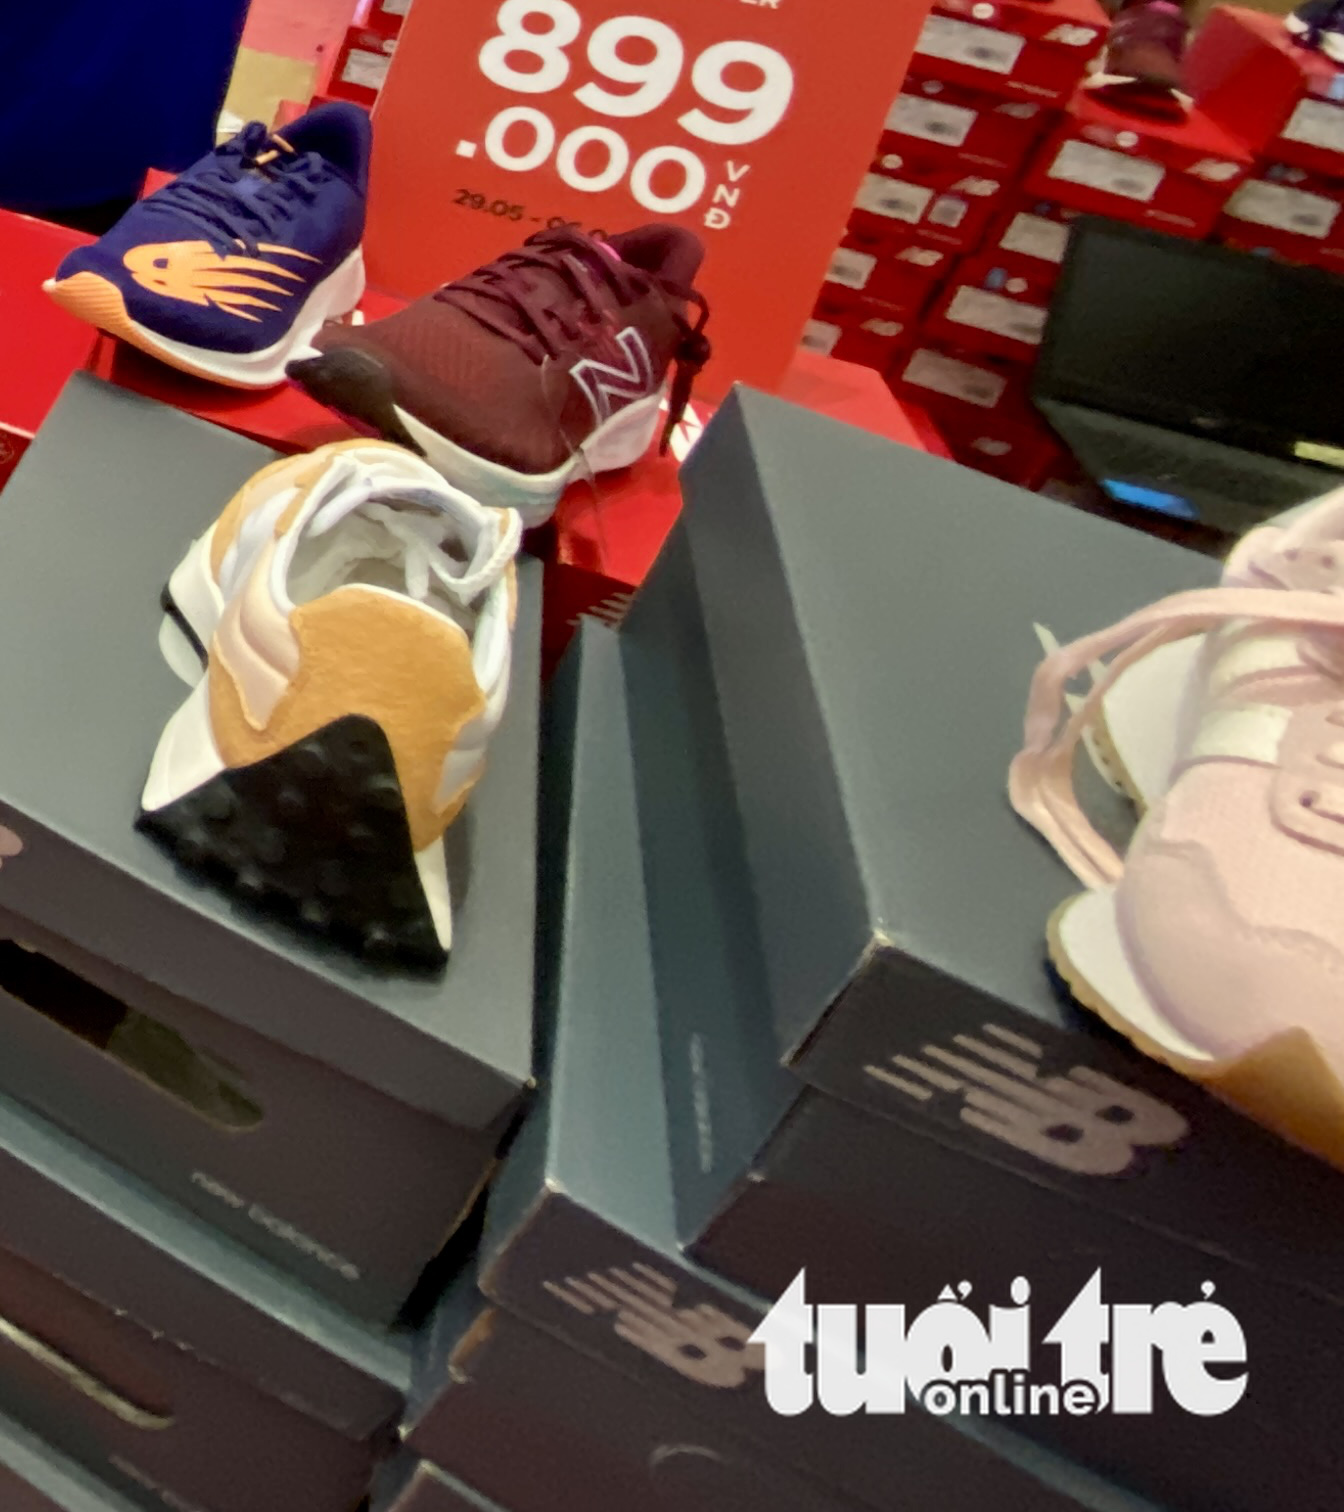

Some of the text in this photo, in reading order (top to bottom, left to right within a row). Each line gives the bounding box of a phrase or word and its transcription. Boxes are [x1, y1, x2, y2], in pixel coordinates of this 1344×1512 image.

[452, 188, 525, 222] 29.05
[569, 327, 653, 430] N
[863, 1022, 1192, 1178] NB
